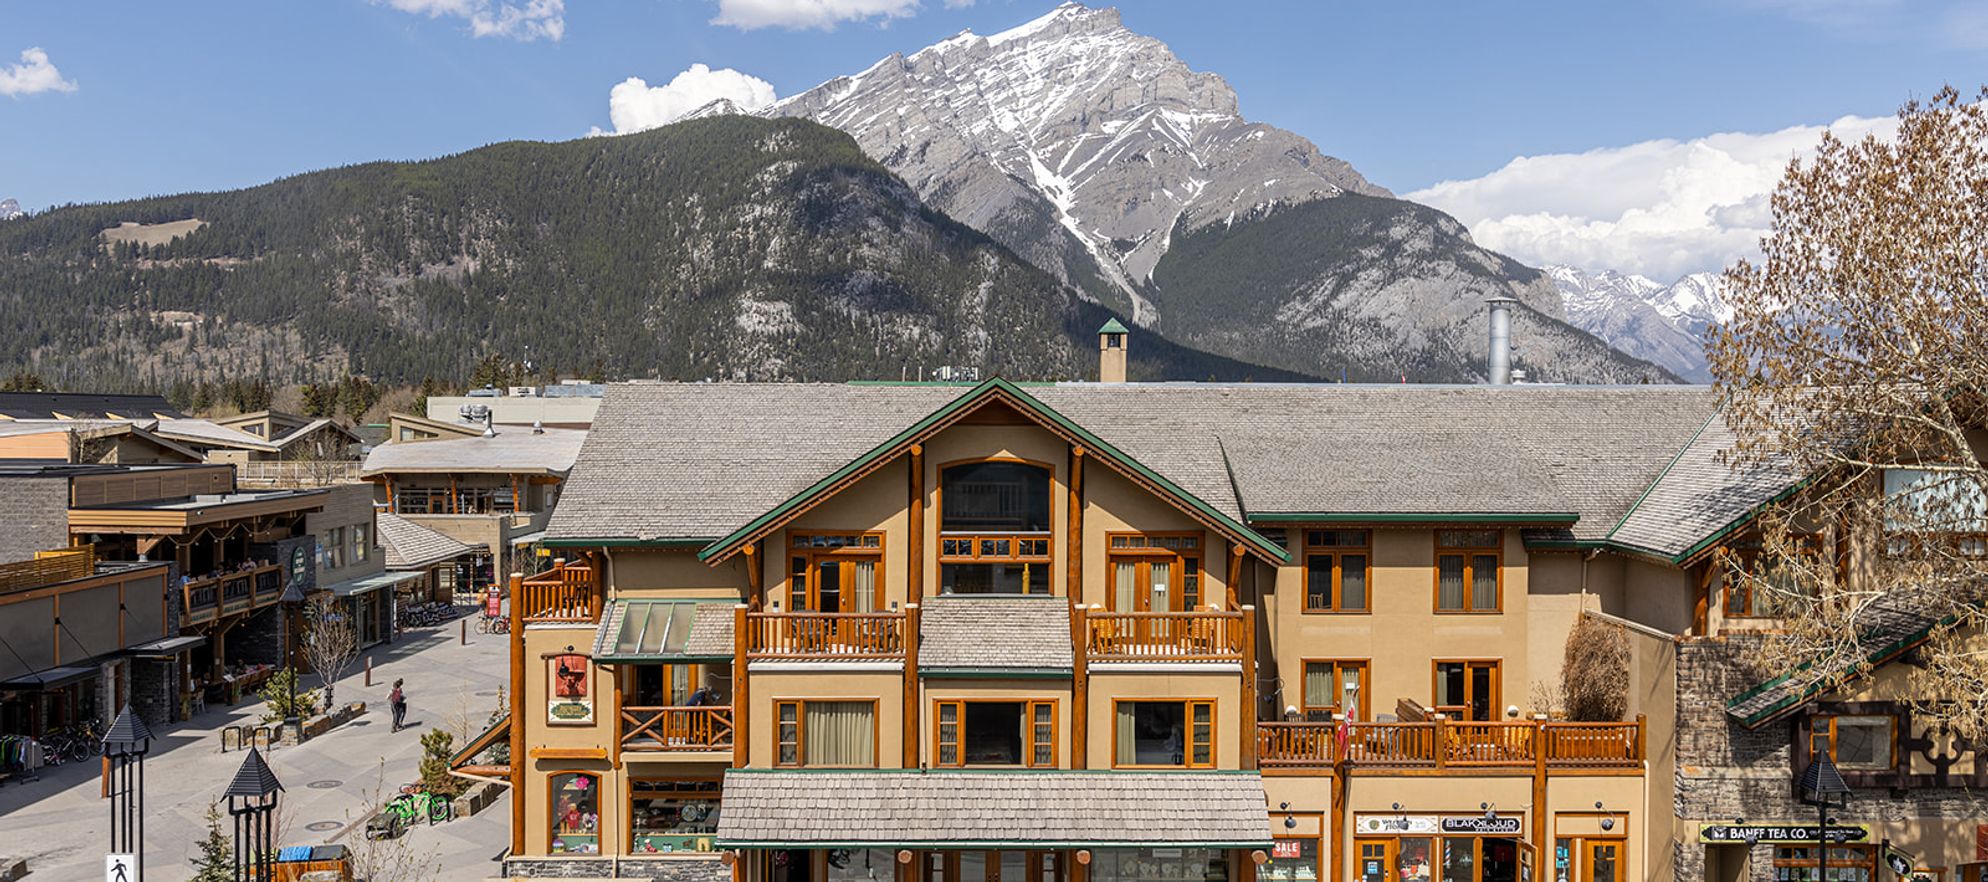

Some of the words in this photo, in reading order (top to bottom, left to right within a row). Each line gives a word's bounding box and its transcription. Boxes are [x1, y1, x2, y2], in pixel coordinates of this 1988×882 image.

[1730, 828, 1765, 839] BANFF
[1768, 828, 1788, 839] TEA
[1790, 828, 1809, 839] CO.
[1275, 842, 1297, 852] SALE
